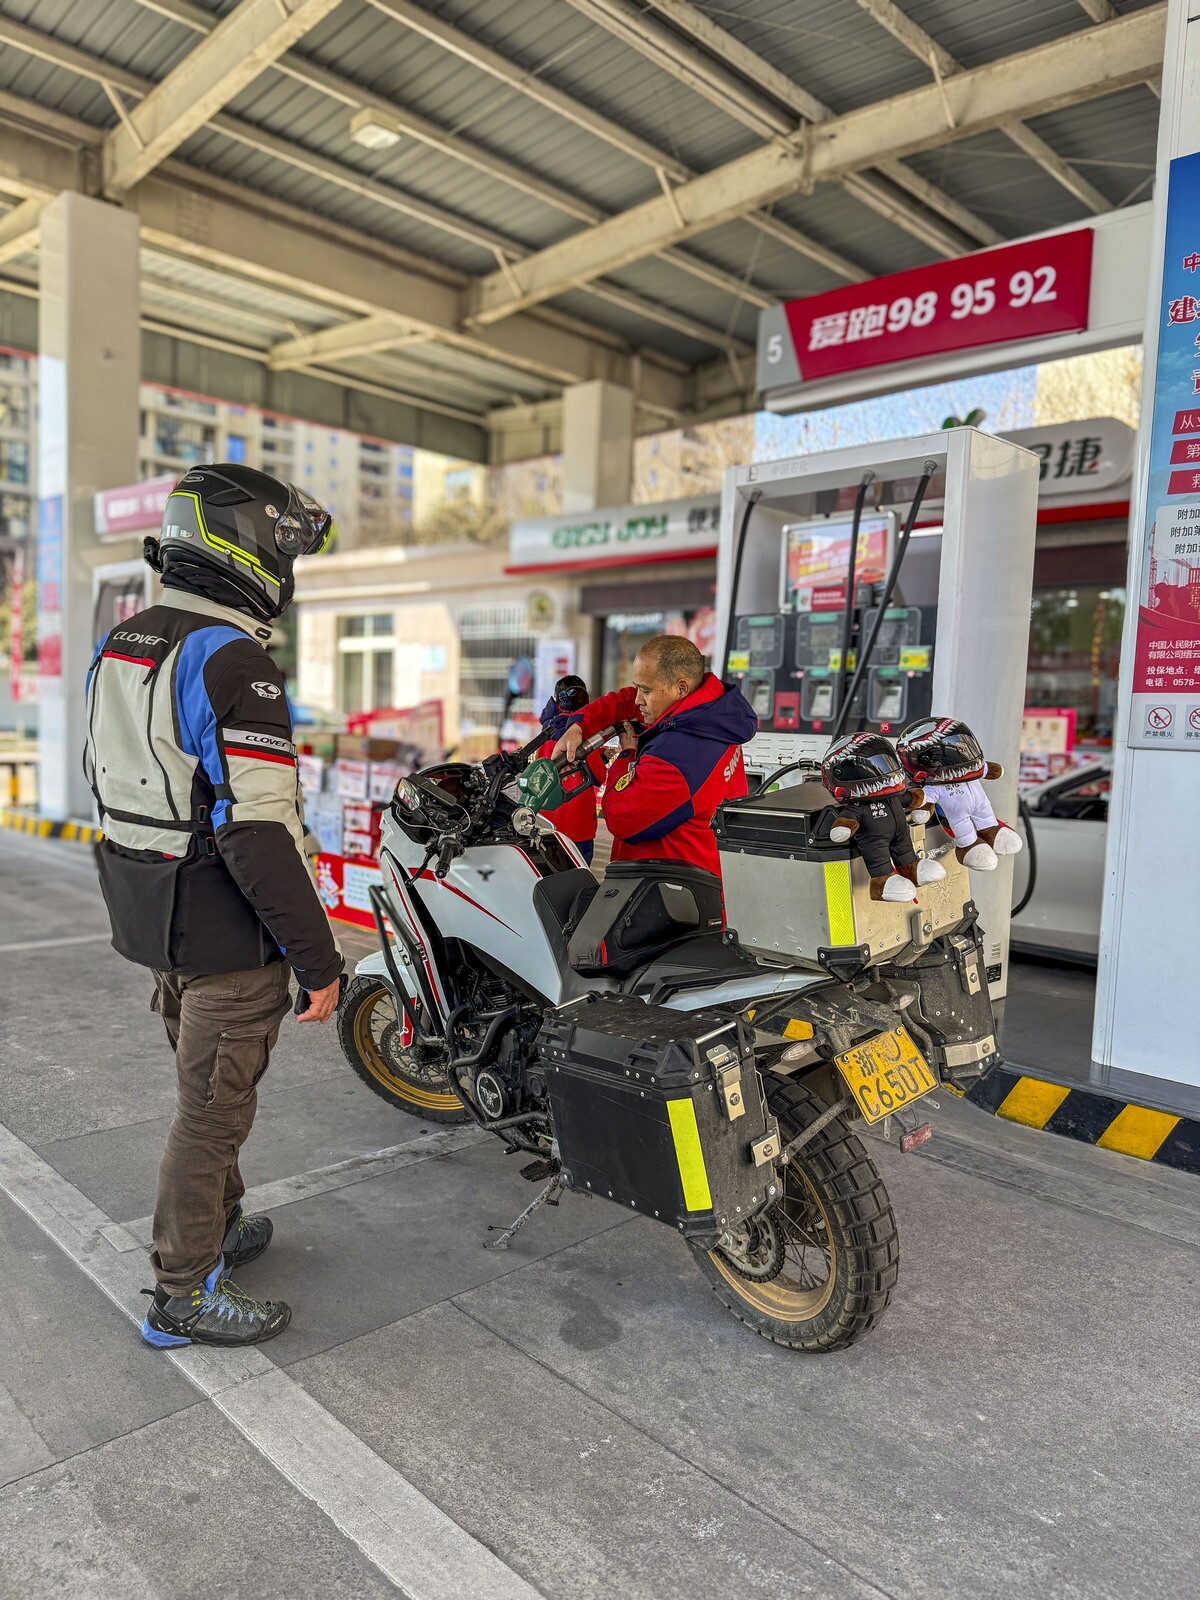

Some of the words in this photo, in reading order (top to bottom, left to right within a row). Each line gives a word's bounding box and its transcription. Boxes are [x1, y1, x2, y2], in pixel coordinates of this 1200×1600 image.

[808, 290, 939, 352] 爱跑98
[950, 277, 996, 320] 95
[1008, 265, 1058, 308] 92
[1167, 295, 1200, 327] 建
[766, 334, 783, 365] 5
[1177, 508, 1200, 521] 附加
[1175, 542, 1200, 555] 附加
[858, 1056, 930, 1117] C650T
